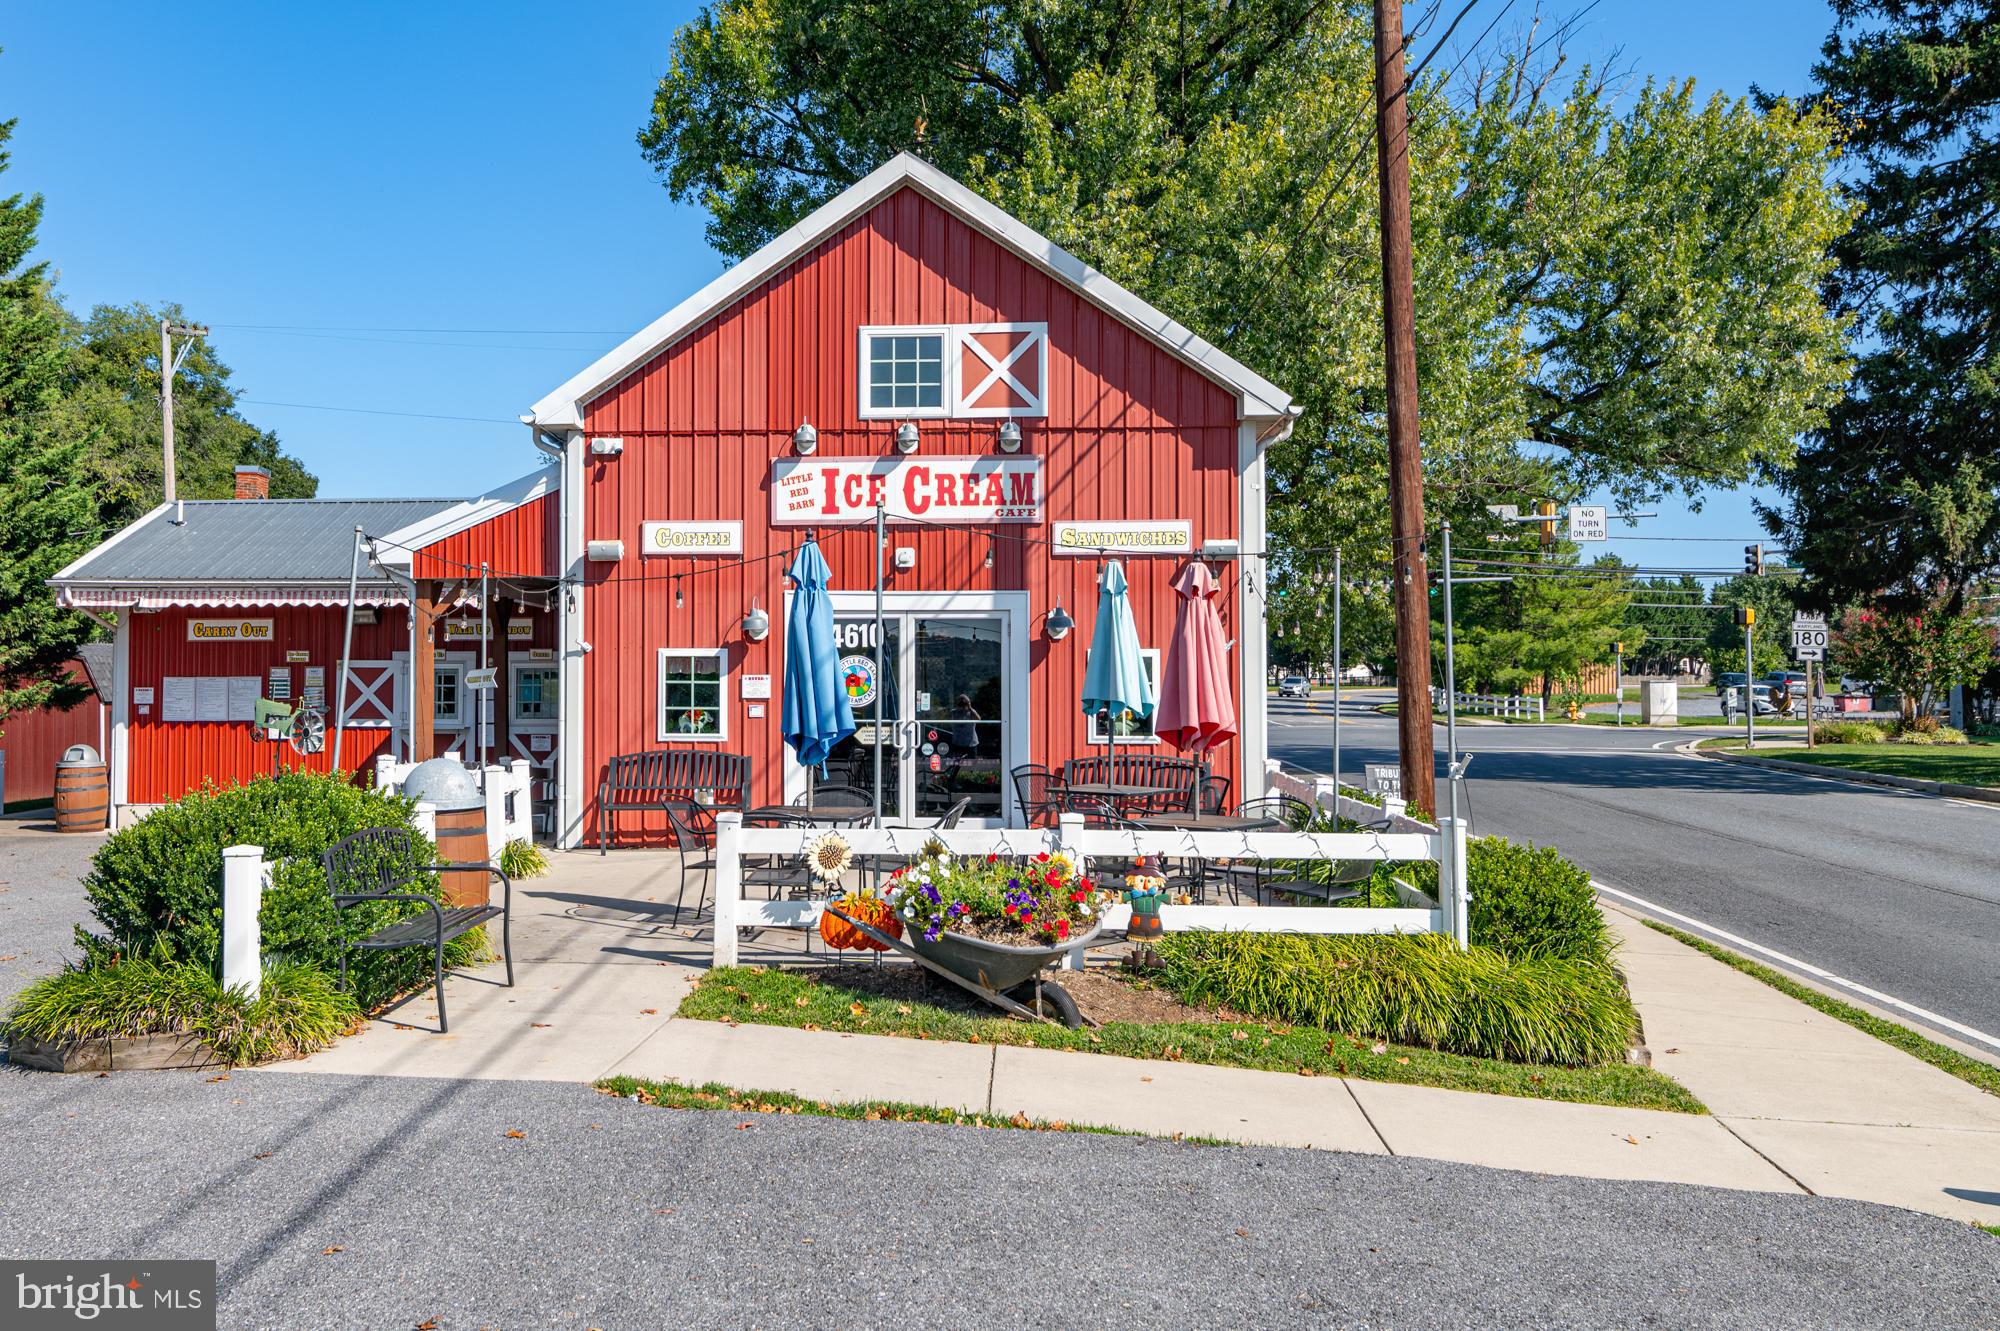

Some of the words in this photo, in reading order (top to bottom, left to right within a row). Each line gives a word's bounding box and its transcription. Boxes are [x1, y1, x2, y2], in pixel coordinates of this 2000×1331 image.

[781, 472, 814, 487] LITTLE
[790, 487, 809, 498] RED
[821, 467, 886, 514] ICE
[902, 465, 1035, 515] CREAM
[788, 498, 815, 511] BARN
[995, 508, 1036, 517] CAFE
[1582, 510, 1594, 518] NO
[655, 528, 731, 548] COFFEE
[1061, 528, 1187, 546] SANDWICHES
[193, 622, 237, 637] CARRY
[241, 622, 268, 637] OUT
[833, 624, 884, 648] 4610
[1795, 632, 1825, 645] 180
[841, 658, 856, 672] ITTLE
[858, 658, 869, 667] RED
[1374, 768, 1400, 778] TRIBU
[1377, 780, 1389, 790] TO
